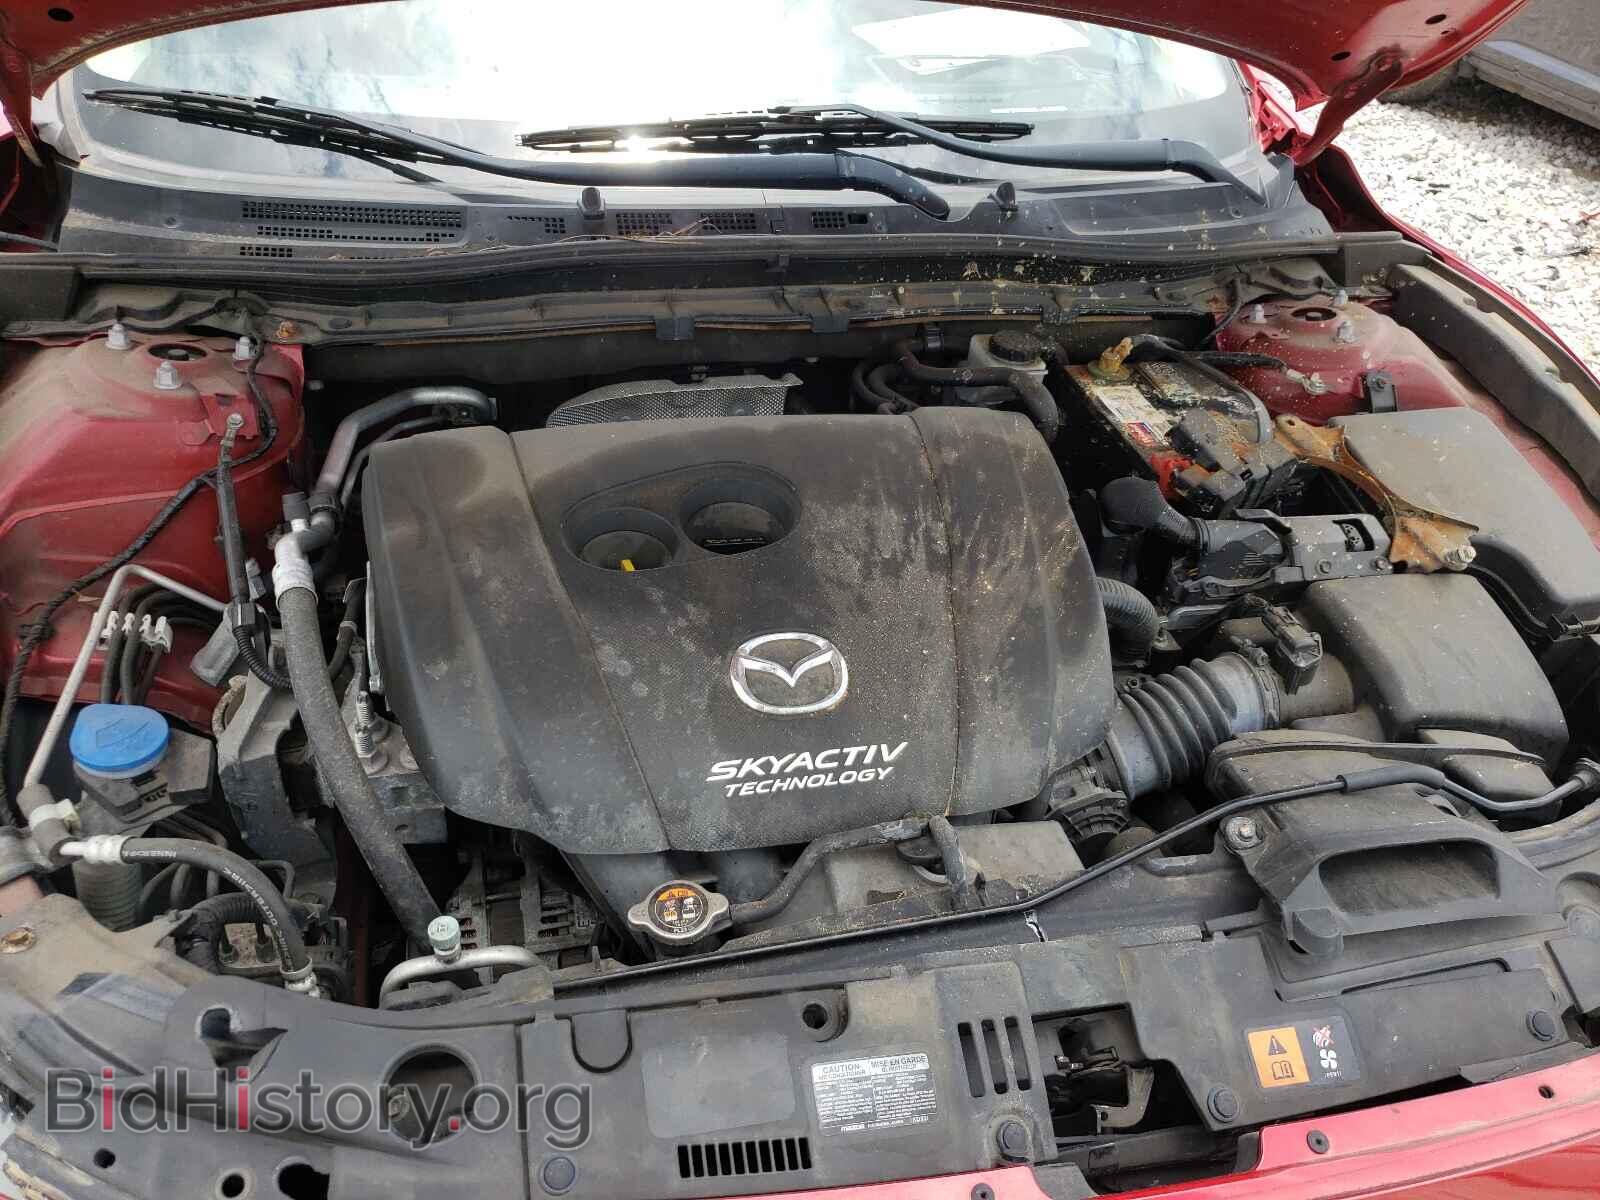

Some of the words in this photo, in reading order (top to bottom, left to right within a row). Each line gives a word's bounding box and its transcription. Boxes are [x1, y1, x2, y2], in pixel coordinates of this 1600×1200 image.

[705, 742, 908, 782] SKYACTIV
[724, 766, 895, 797] TECHNOLOGY
[823, 1063, 861, 1074] CAUTION
